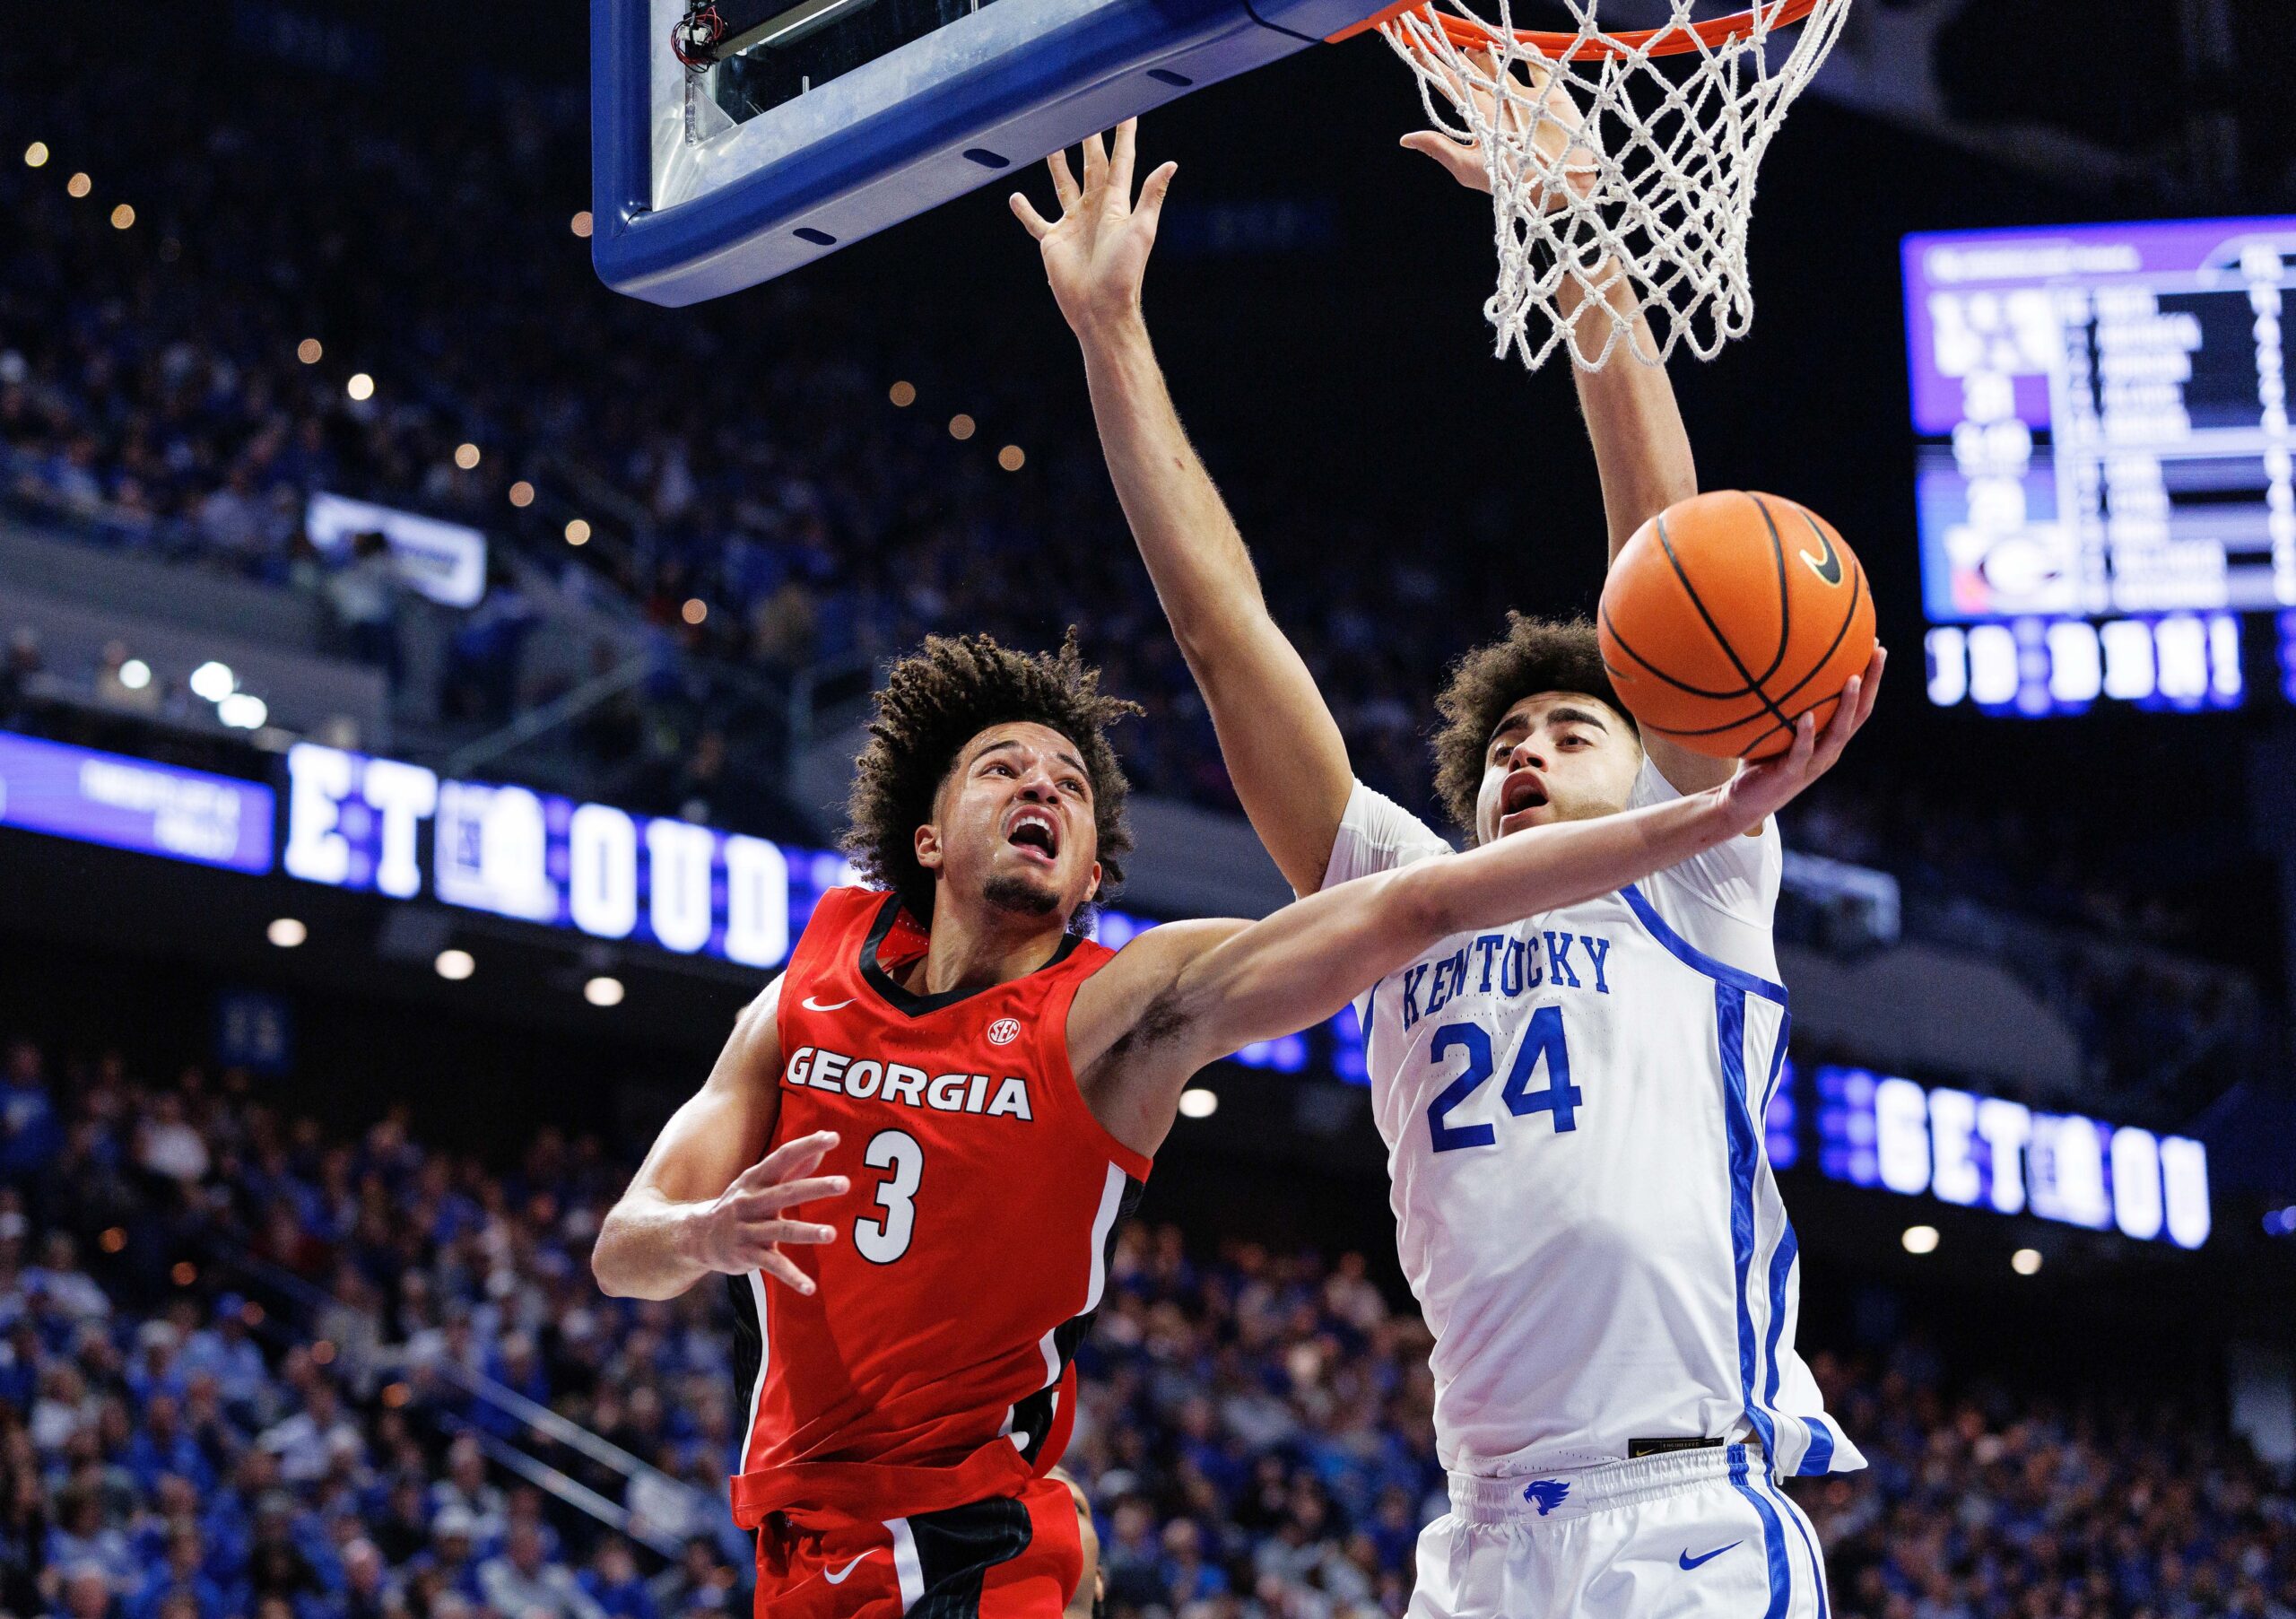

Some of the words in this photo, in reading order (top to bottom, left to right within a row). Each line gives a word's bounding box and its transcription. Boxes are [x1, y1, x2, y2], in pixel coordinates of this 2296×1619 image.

[989, 1020, 1019, 1043] SEC
[1404, 931, 1611, 1032] KENTUCKY
[786, 1046, 1034, 1121] GEORGIA
[1427, 1005, 1583, 1153] 24
[853, 1127, 925, 1266] 3
